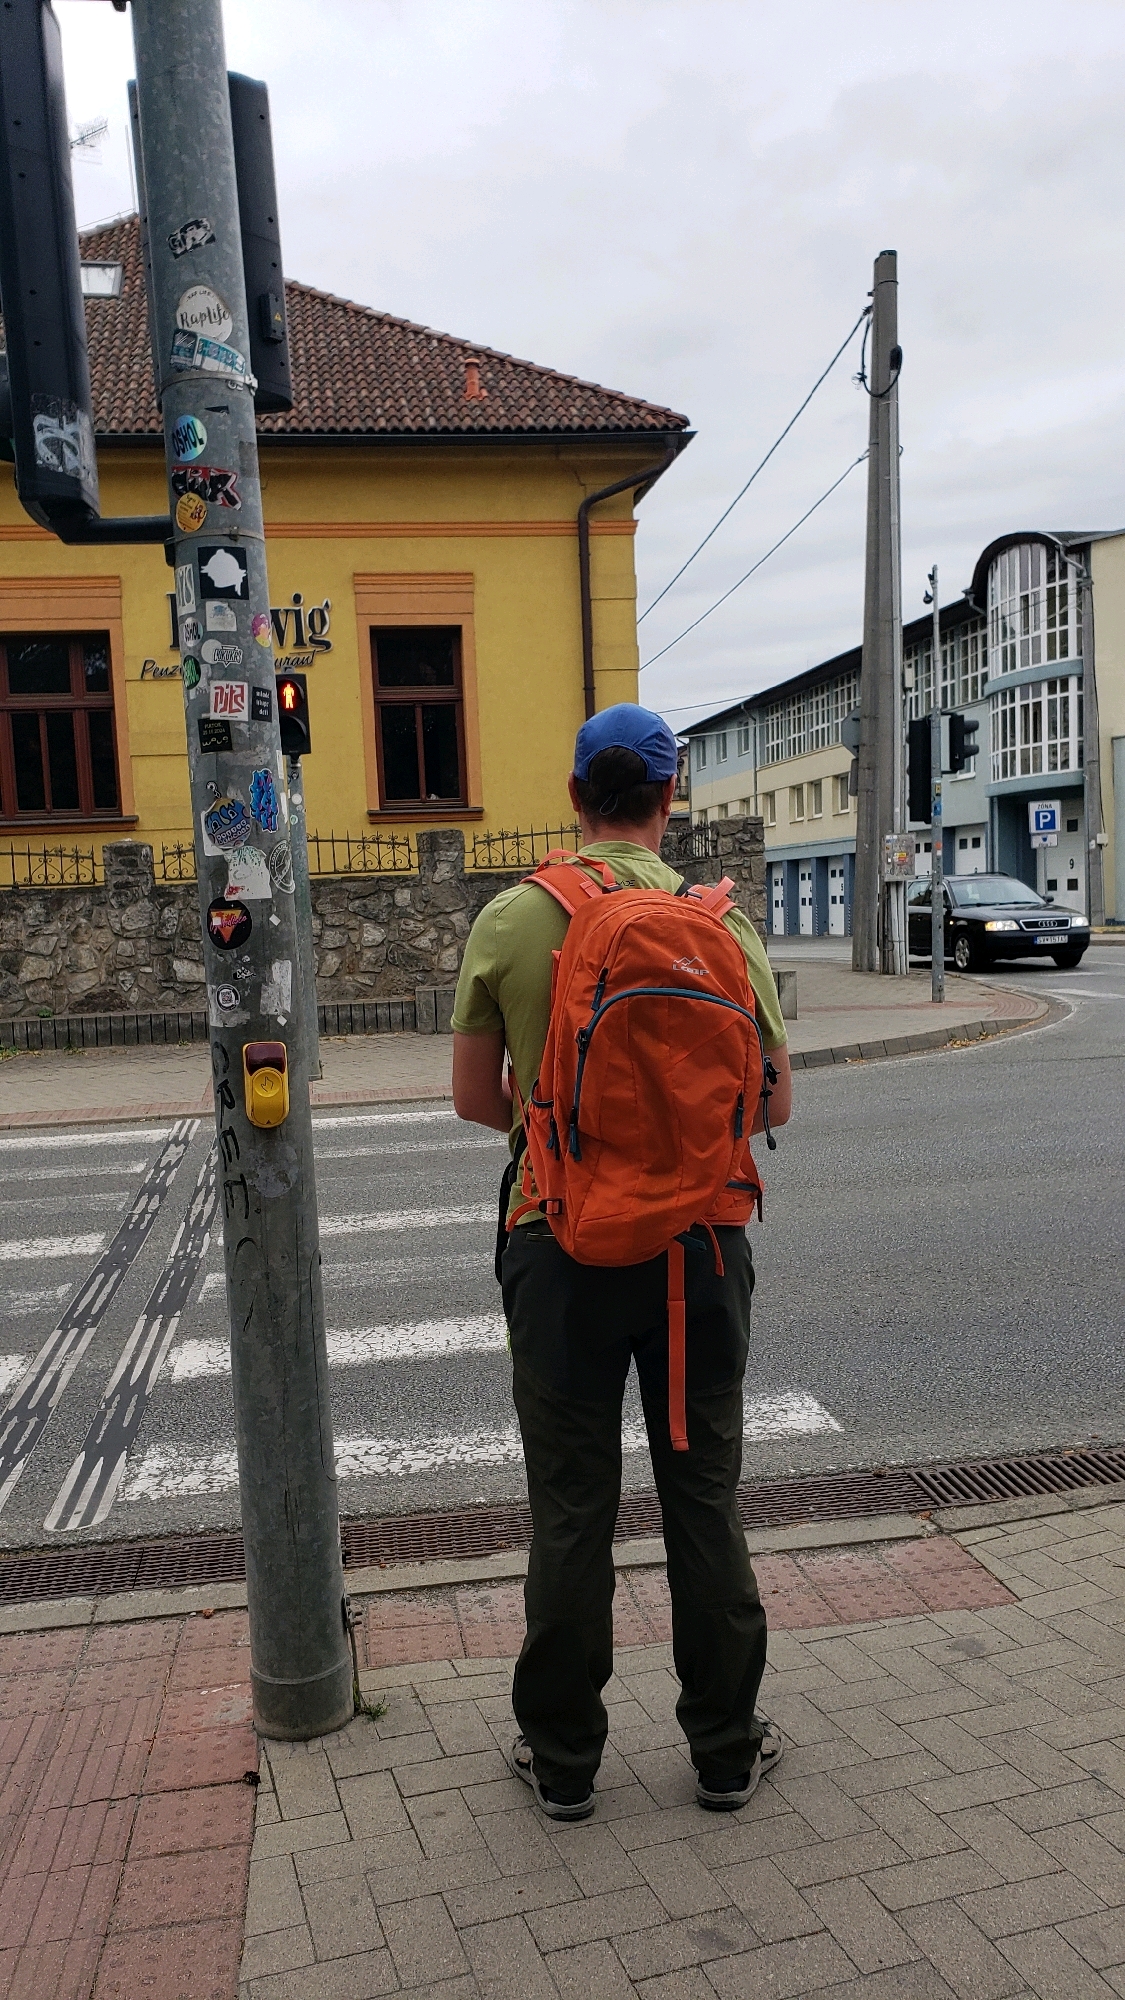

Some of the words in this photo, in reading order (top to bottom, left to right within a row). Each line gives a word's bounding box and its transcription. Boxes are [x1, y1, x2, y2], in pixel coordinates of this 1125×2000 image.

[172, 420, 205, 458] OSHOL
[1039, 811, 1051, 829] P
[1069, 858, 1075, 870] 9
